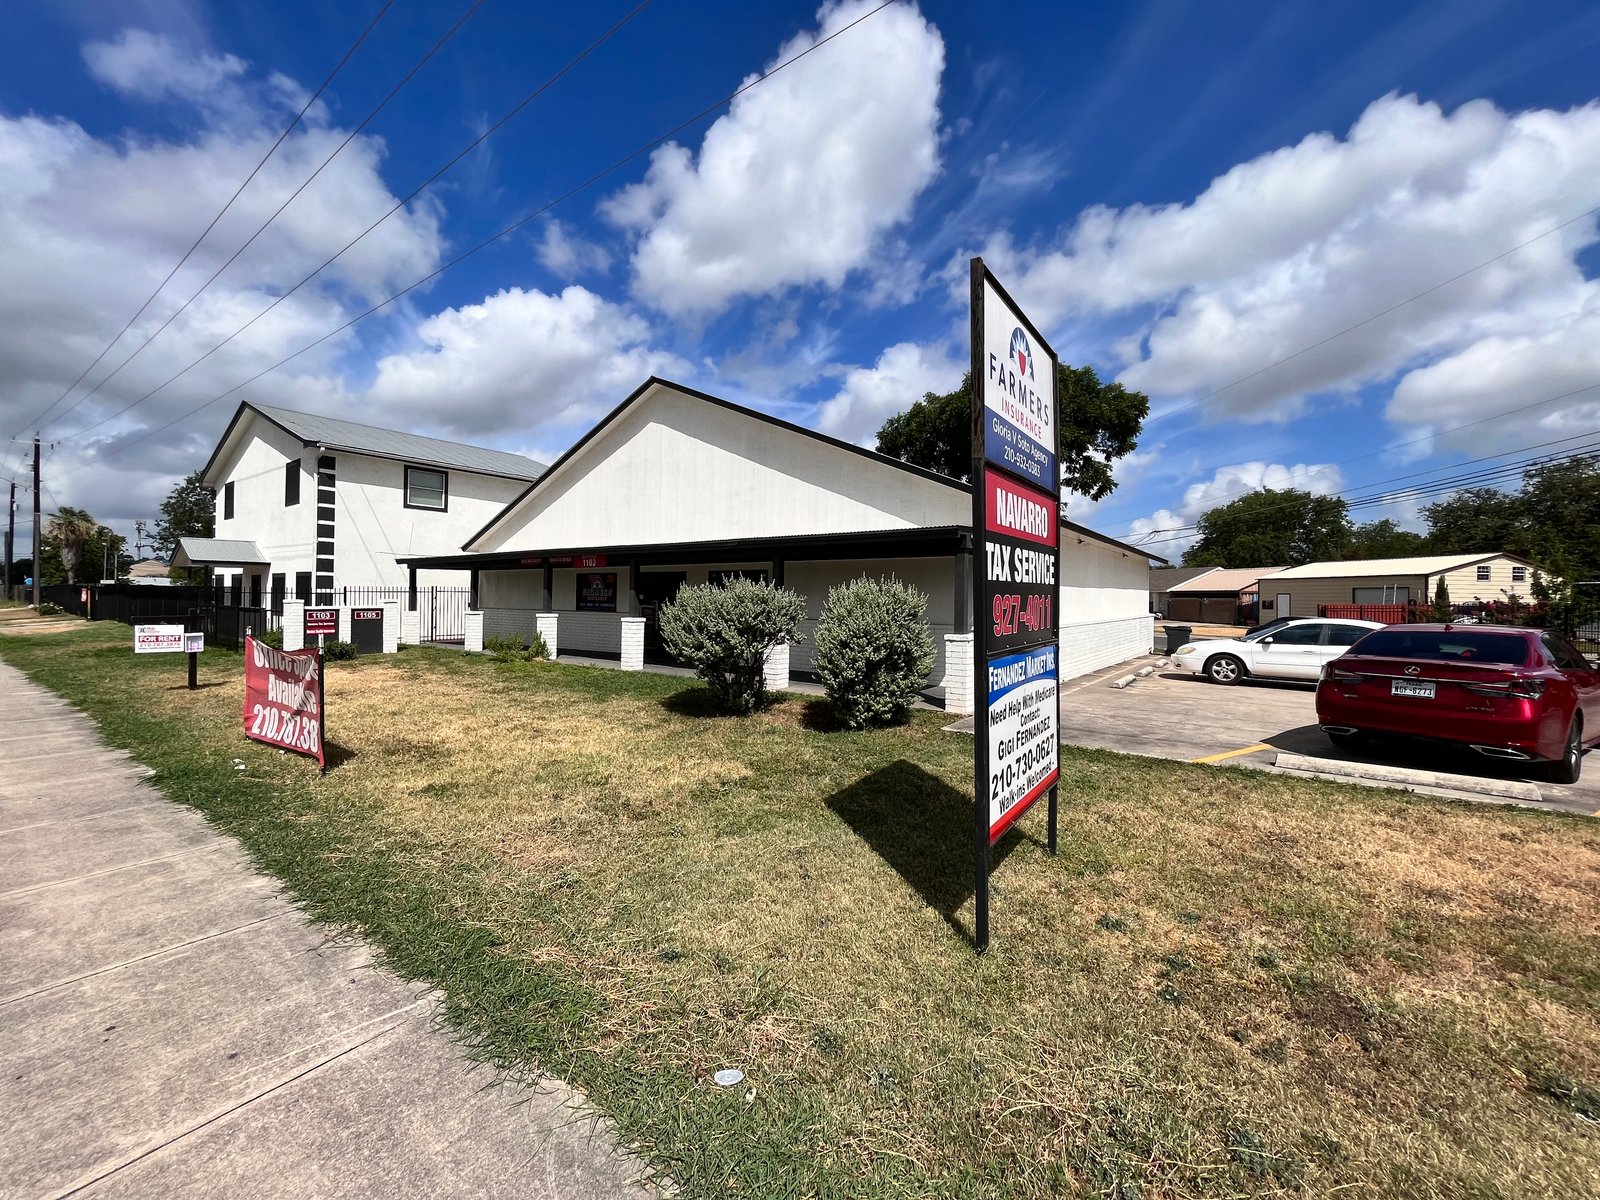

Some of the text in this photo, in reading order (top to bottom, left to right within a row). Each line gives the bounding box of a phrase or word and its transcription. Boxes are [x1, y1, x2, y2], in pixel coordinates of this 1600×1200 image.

[990, 352, 1049, 427] FARMERS
[1001, 397, 1042, 440] INSURANCE
[992, 417, 1013, 442] Gloria
[1017, 434, 1031, 453] Soto
[1030, 443, 1049, 468] Agency
[996, 487, 1048, 539] NAVARRO
[985, 541, 1055, 585] TAX SERVICE
[312, 611, 331, 619] 1103
[992, 594, 1051, 637] 927-4011
[988, 661, 1026, 692] FERNANDEZ
[1025, 656, 1046, 679] MARKET
[989, 685, 1056, 728] Need Help With Medicare
[997, 716, 1051, 761] GIGI FERNANDEZ
[991, 733, 1056, 801] 210-730-0627
